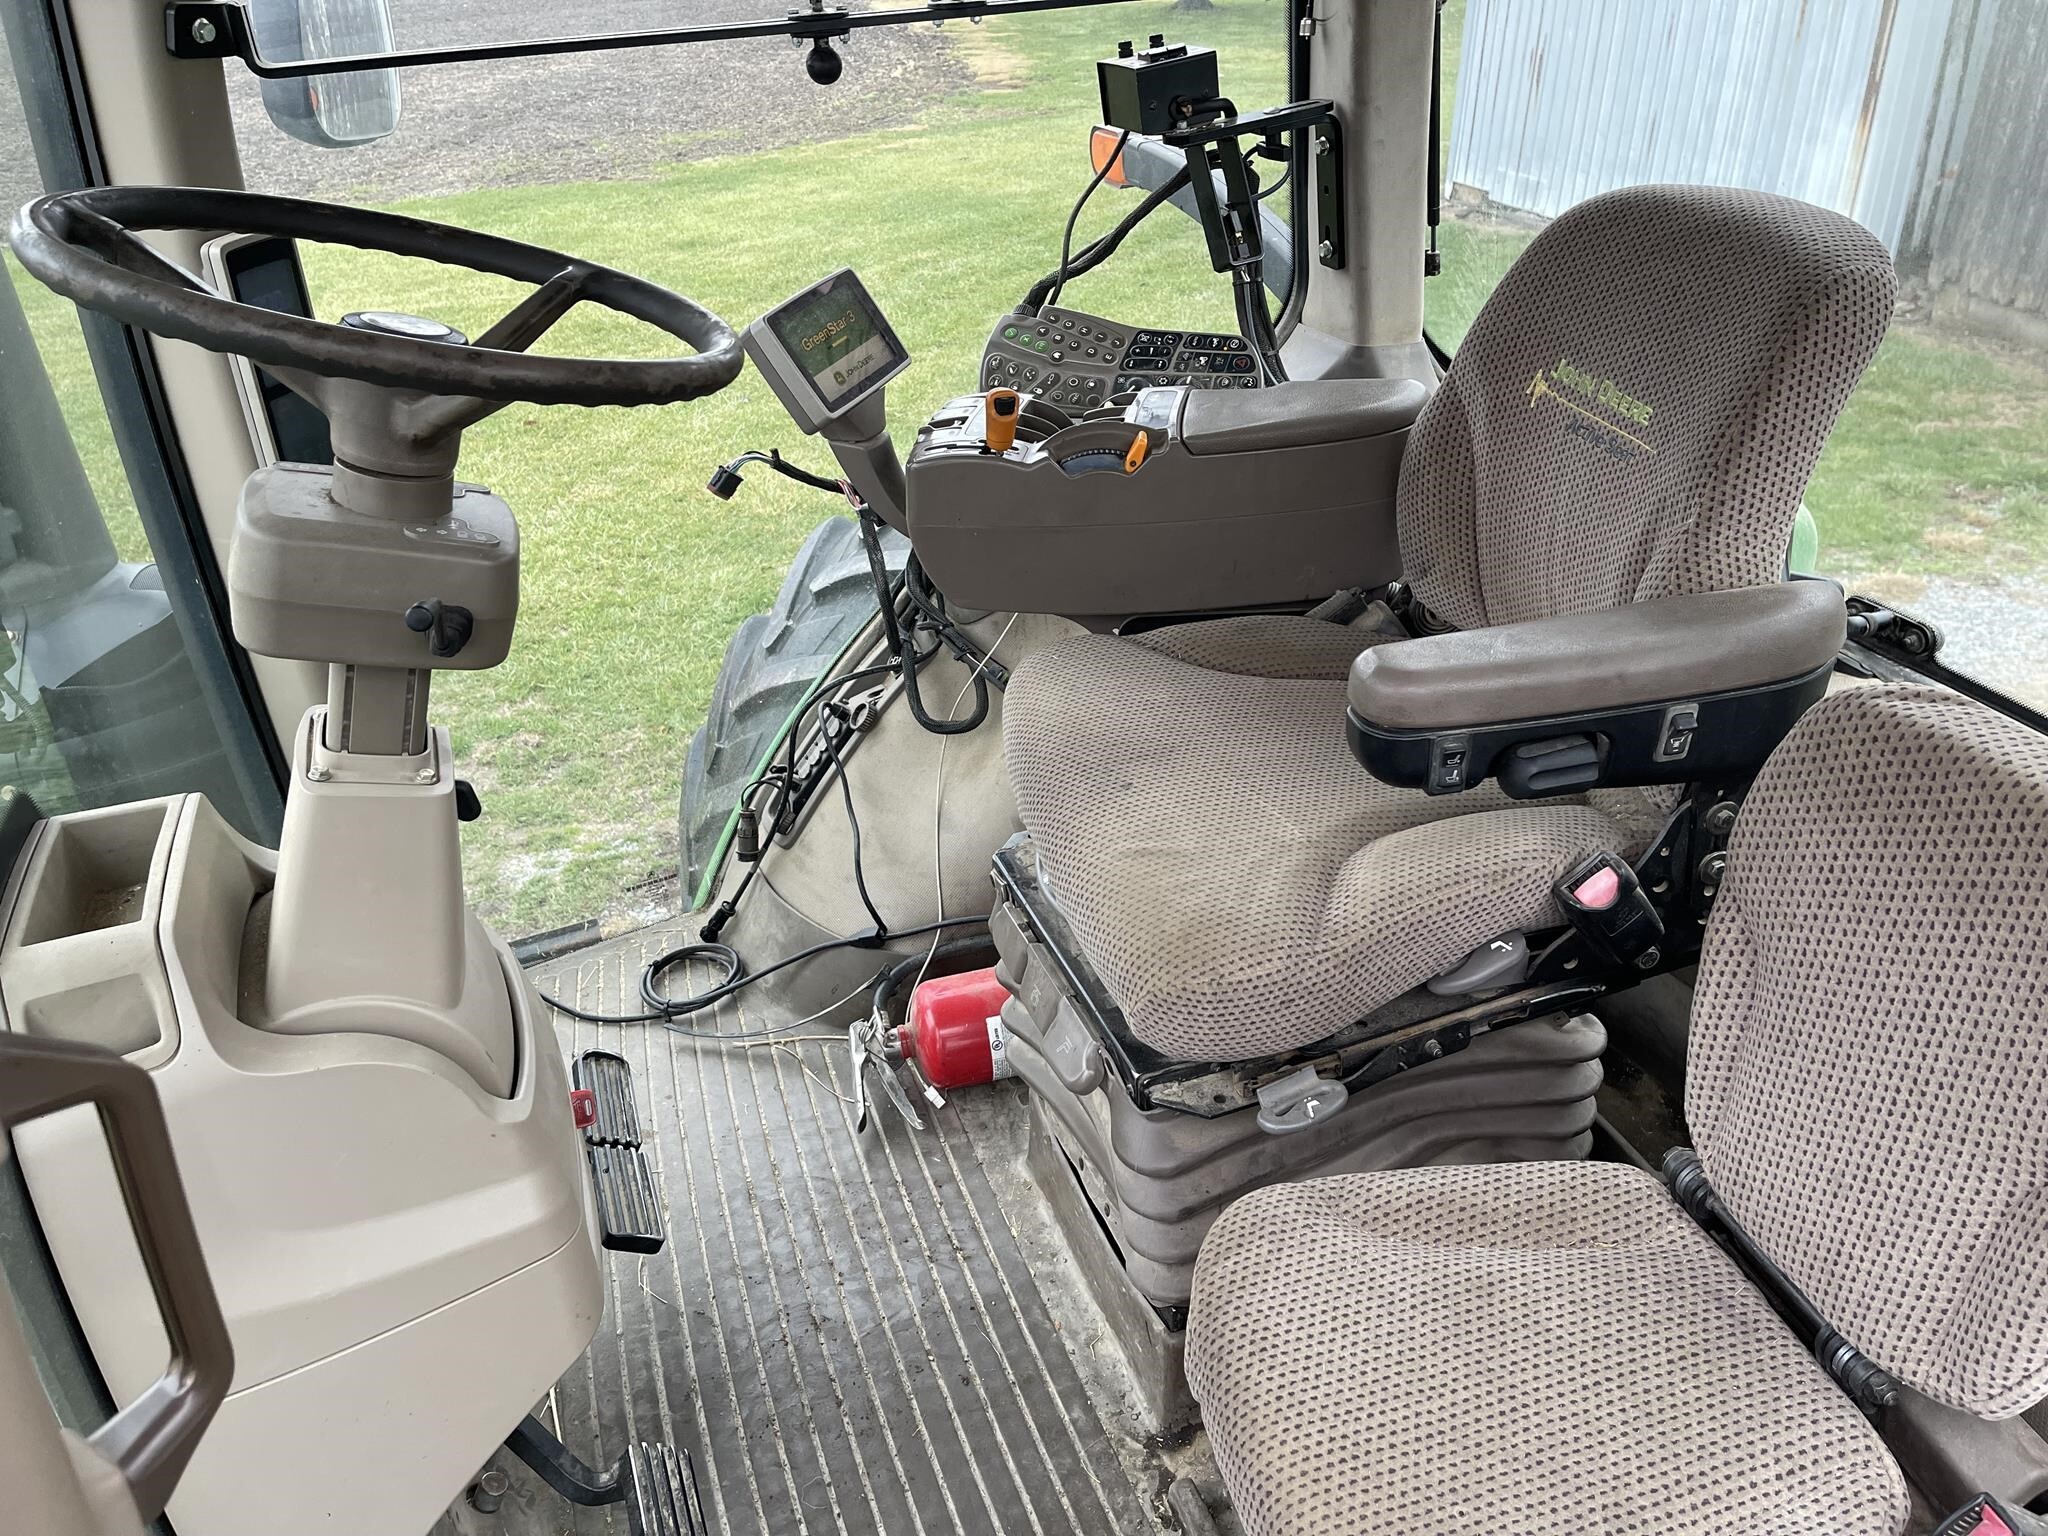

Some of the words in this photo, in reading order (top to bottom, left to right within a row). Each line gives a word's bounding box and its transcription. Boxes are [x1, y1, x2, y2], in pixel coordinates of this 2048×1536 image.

[801, 316, 847, 351] GreenStar
[846, 310, 855, 322] 3
[1550, 359, 1597, 398] JOHN
[1598, 379, 1654, 427] DEERE
